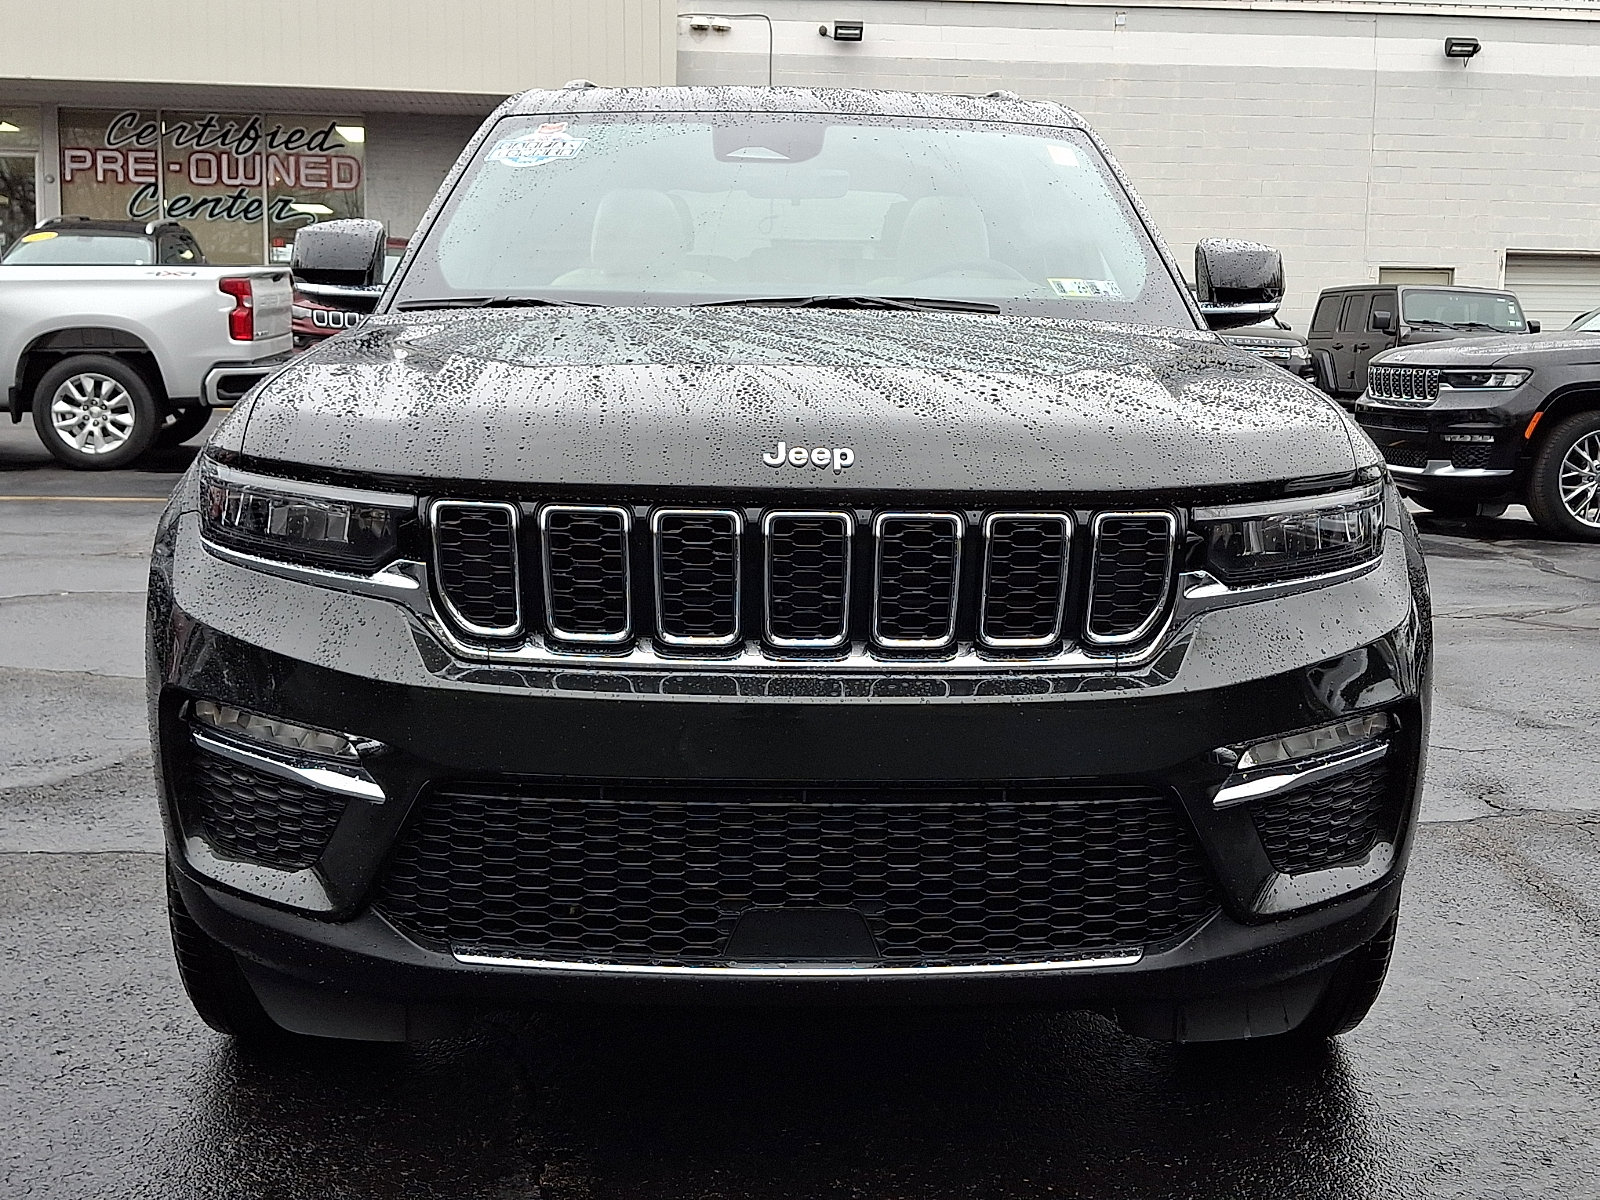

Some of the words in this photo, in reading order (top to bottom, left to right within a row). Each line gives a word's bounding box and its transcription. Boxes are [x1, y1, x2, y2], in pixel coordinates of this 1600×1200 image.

[105, 111, 346, 155] Certified
[62, 148, 362, 190] PRE-OWNED
[127, 182, 317, 224] Center
[762, 441, 855, 473] Jeep
